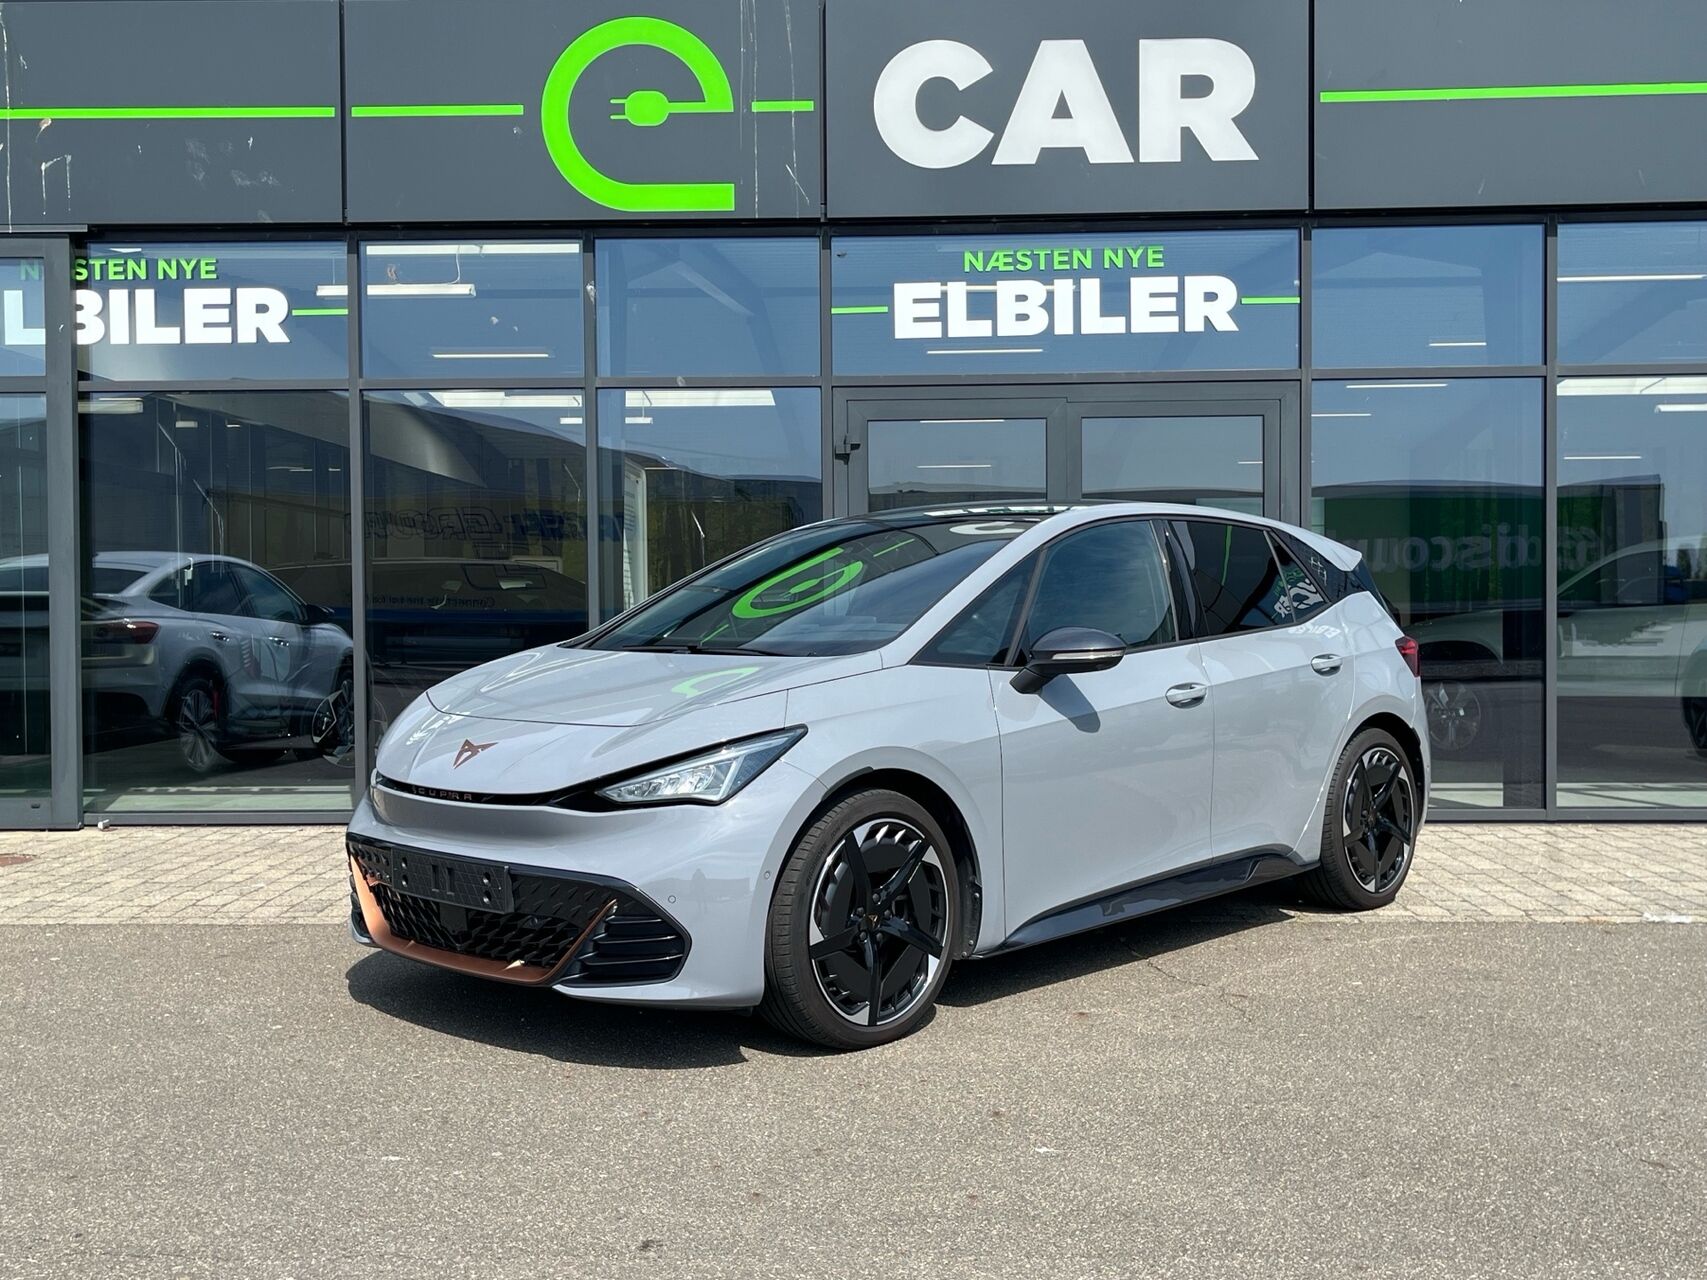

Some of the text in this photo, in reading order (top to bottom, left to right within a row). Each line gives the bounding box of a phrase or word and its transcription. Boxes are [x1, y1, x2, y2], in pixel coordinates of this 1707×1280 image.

[873, 38, 1259, 169] CAR
[20, 257, 218, 281] NSTEN NYE
[964, 245, 1165, 273] NÆSTEN NYE
[894, 275, 1239, 339] ELBILER
[417, 787, 473, 801] CUPRA
